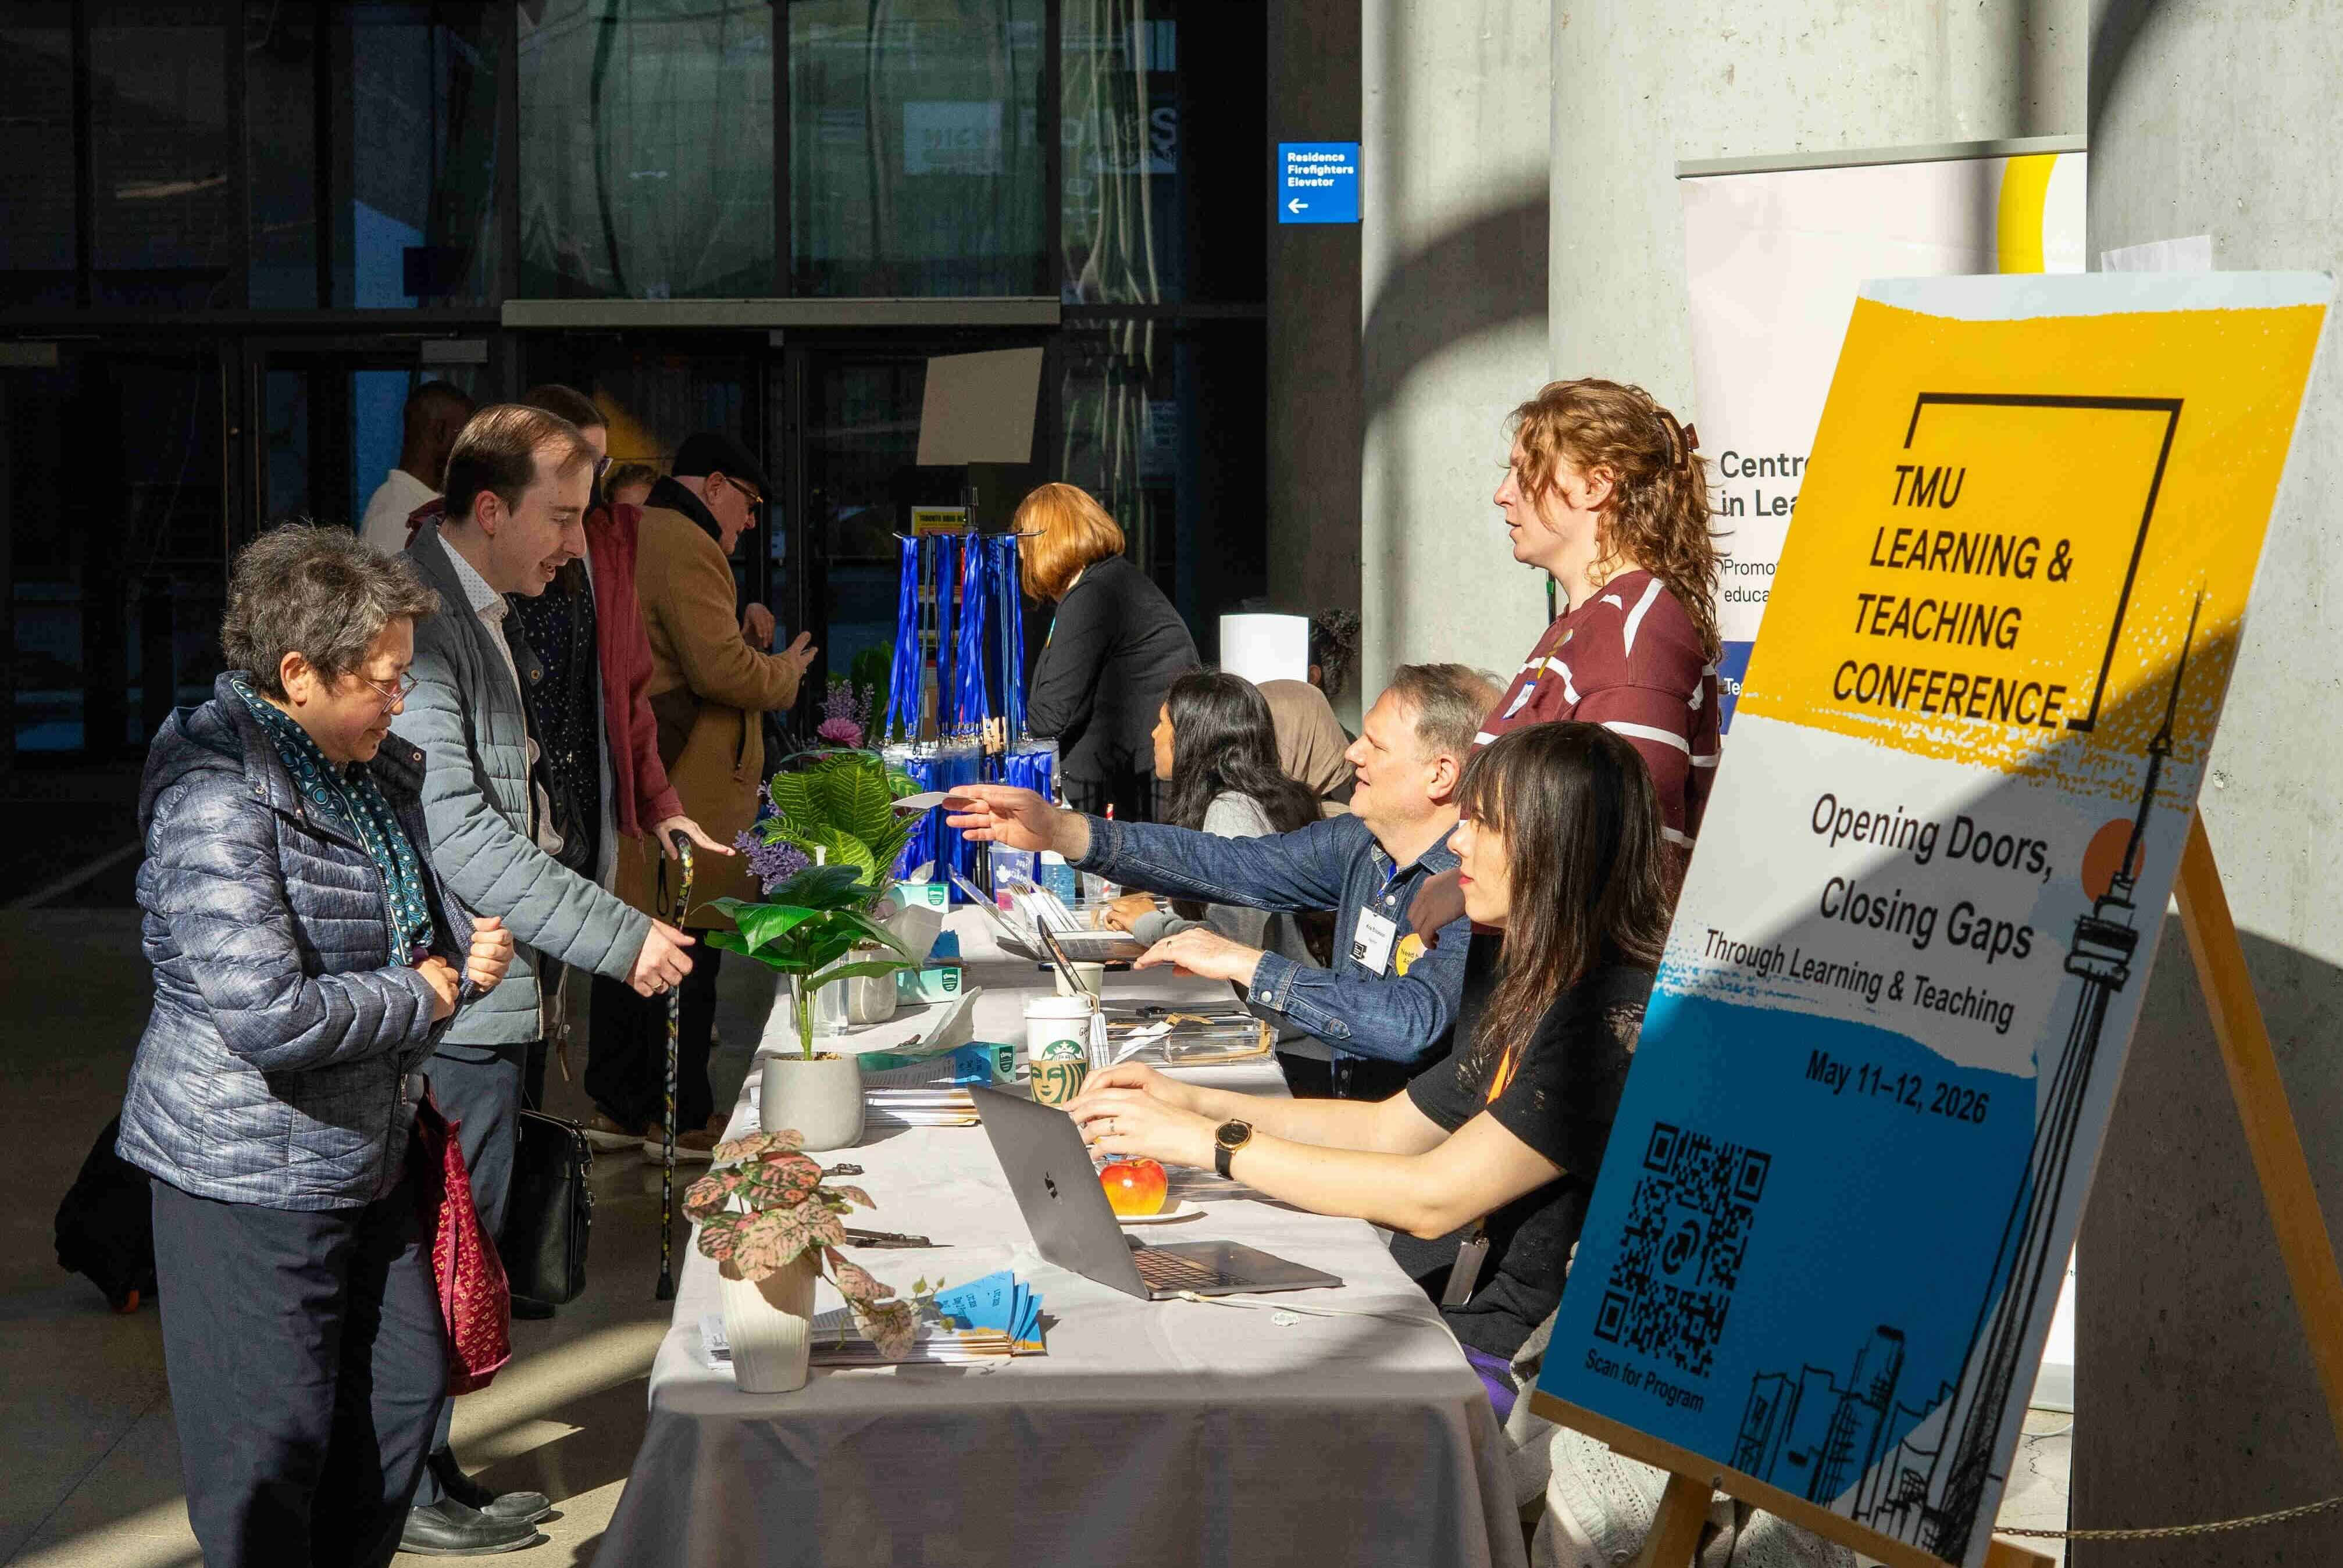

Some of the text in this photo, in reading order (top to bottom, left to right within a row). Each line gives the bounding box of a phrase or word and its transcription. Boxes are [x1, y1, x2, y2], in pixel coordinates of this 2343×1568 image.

[1288, 152, 1345, 162] Residence
[1288, 165, 1354, 176] Firefighters
[1288, 177, 1335, 187] Elevator
[1721, 451, 1810, 478] Centr
[1892, 465, 1966, 509] TMU
[1722, 490, 1744, 516] in
[1724, 559, 1779, 576] Promo
[1870, 526, 2073, 583] LEARNING &
[1855, 592, 2021, 650] TEACHING
[1724, 677, 1743, 696] Te
[1834, 660, 2067, 728] CONFERENCE
[1812, 793, 2052, 884] Opening Doors,
[1820, 877, 2034, 965] Closing Gaps
[1704, 928, 2015, 1034] Through Learning & Teaching
[1806, 1050, 1852, 1095] May
[1931, 1083, 1989, 1124] 2026
[1586, 1348, 1704, 1413] Scan for Program
